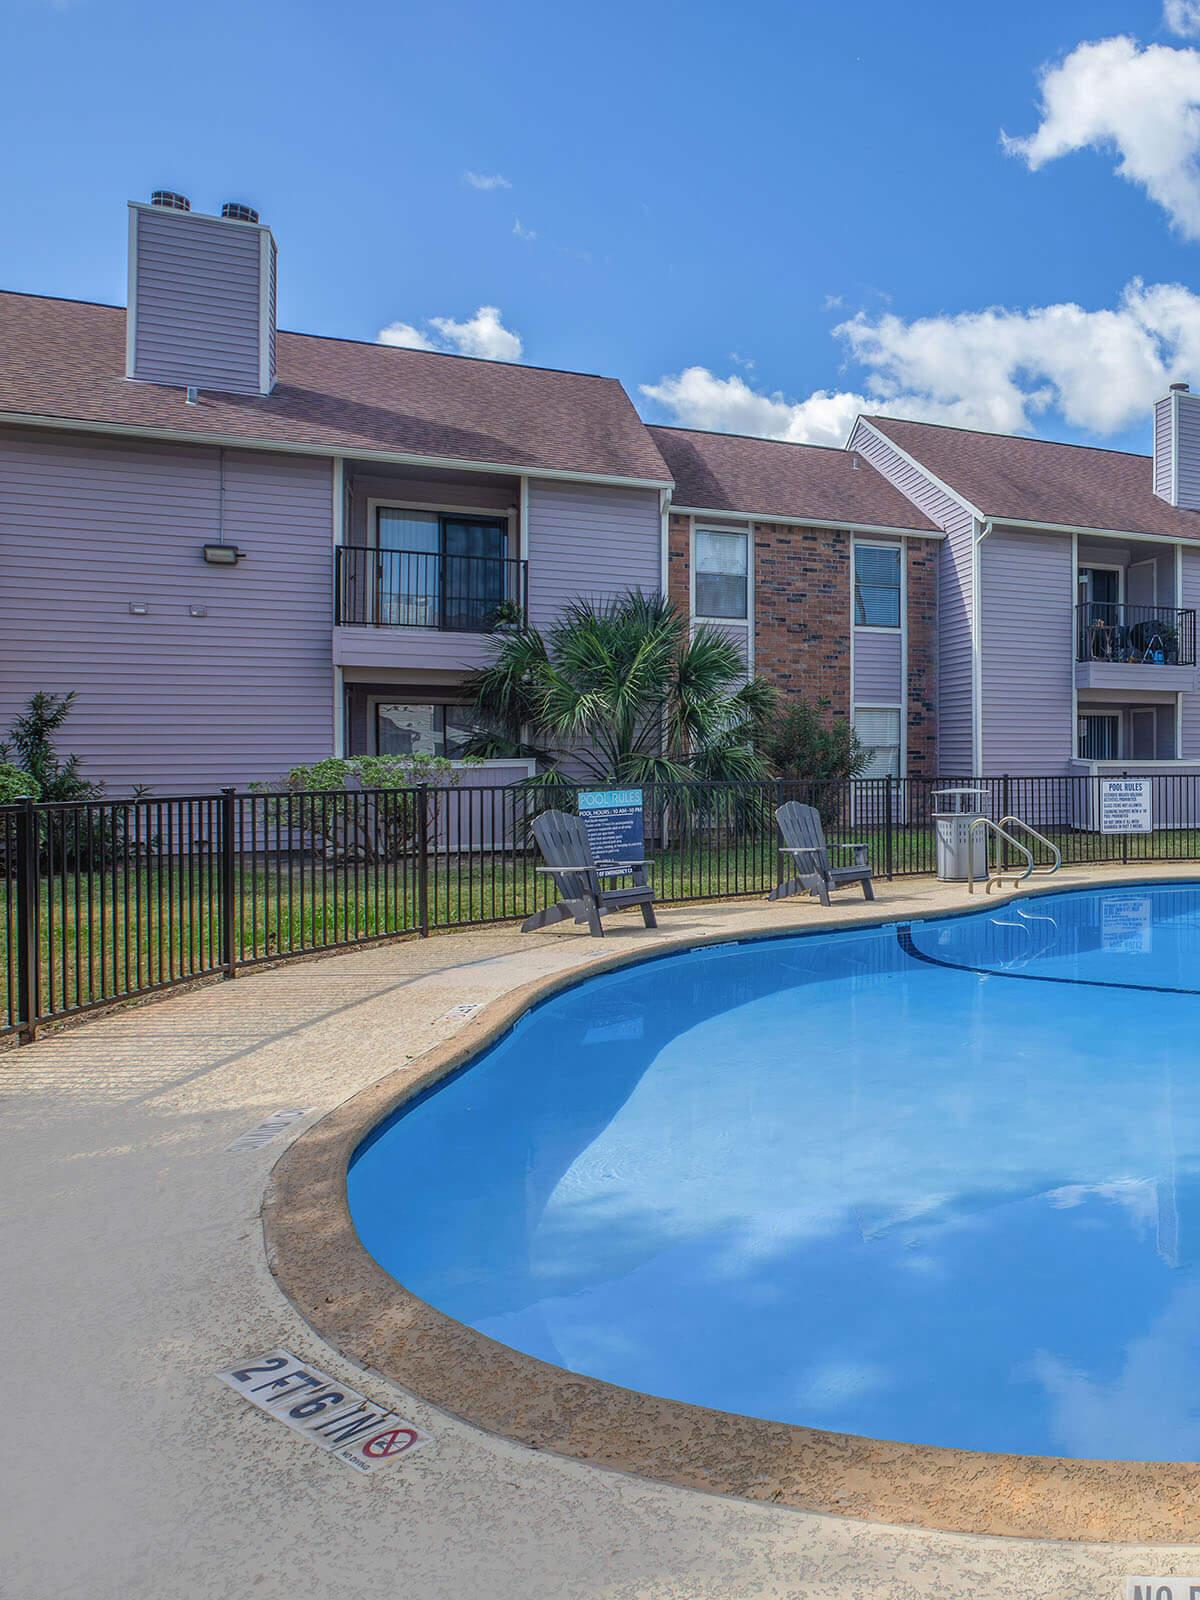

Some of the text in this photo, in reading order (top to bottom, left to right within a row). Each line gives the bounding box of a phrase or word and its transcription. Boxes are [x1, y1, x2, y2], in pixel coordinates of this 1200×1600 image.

[1109, 783, 1143, 791] POOL RULES
[580, 791, 640, 806] POOL RULES
